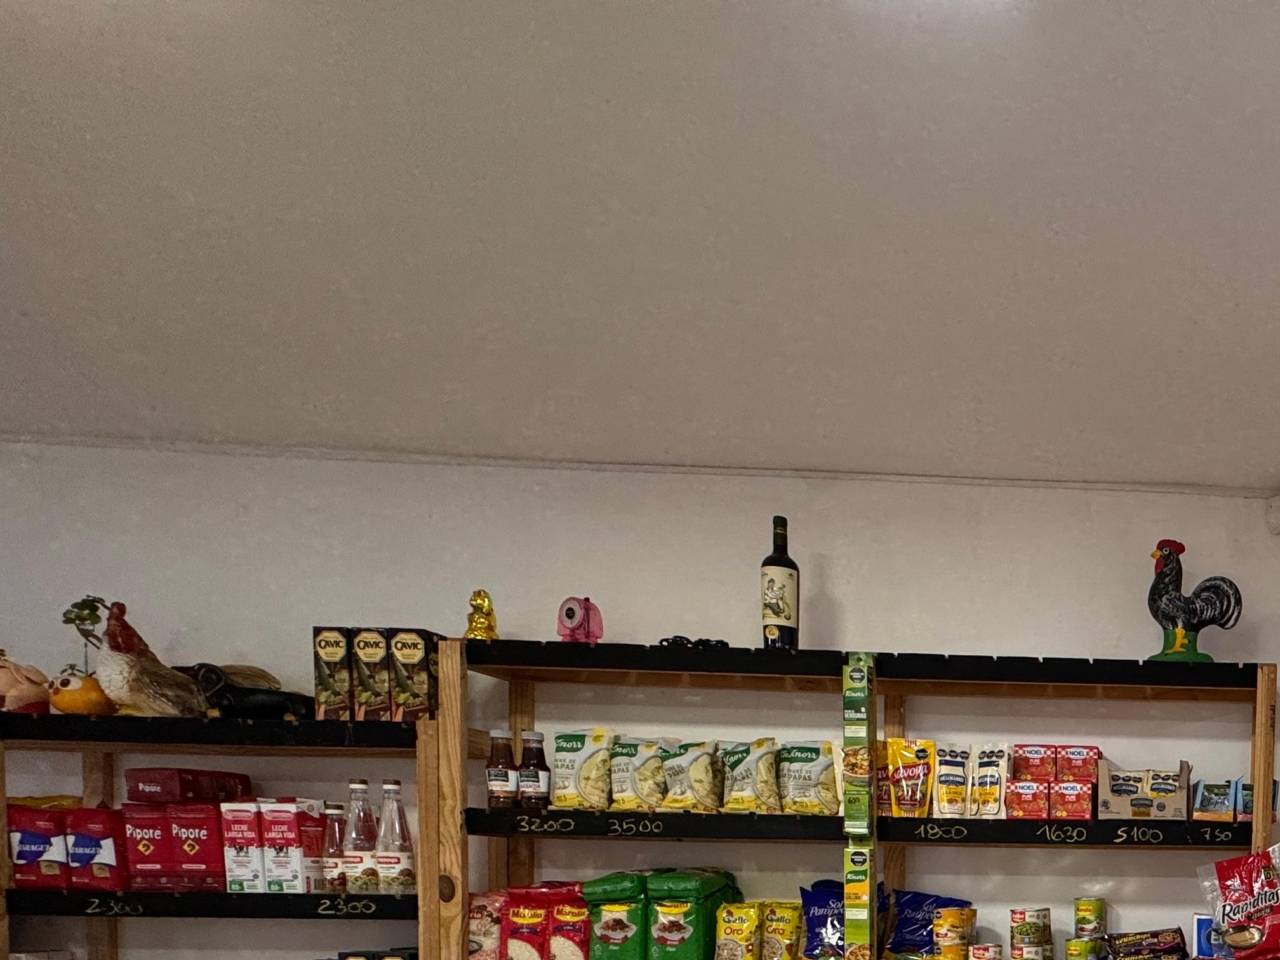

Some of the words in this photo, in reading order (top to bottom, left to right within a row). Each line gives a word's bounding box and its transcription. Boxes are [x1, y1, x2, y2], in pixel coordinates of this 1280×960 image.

[517, 816, 576, 832] 3200
[608, 819, 663, 836] 3500
[915, 824, 968, 839] 1800
[1036, 824, 1087, 842] 1630
[317, 898, 376, 914] 2300
[724, 926, 744, 936] Oro
